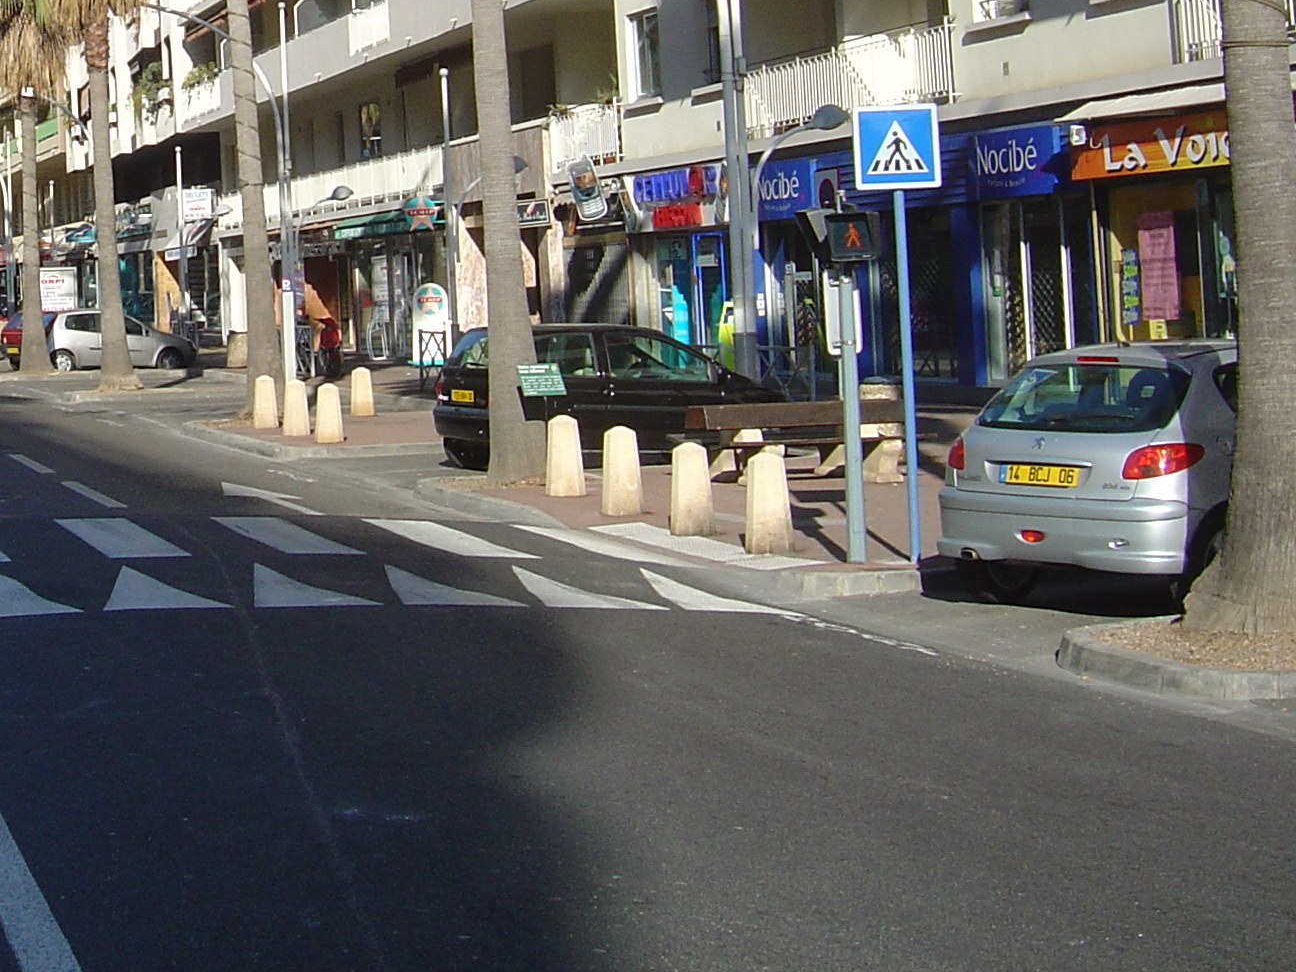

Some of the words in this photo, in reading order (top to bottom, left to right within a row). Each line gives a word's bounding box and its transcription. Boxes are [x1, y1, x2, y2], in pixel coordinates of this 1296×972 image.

[976, 137, 1037, 176] Nocibé
[1102, 133, 1148, 174] La
[758, 170, 800, 201] Nocibé
[1008, 466, 1021, 481] 14
[1028, 467, 1050, 483] BCJ
[1058, 468, 1074, 484] 06
